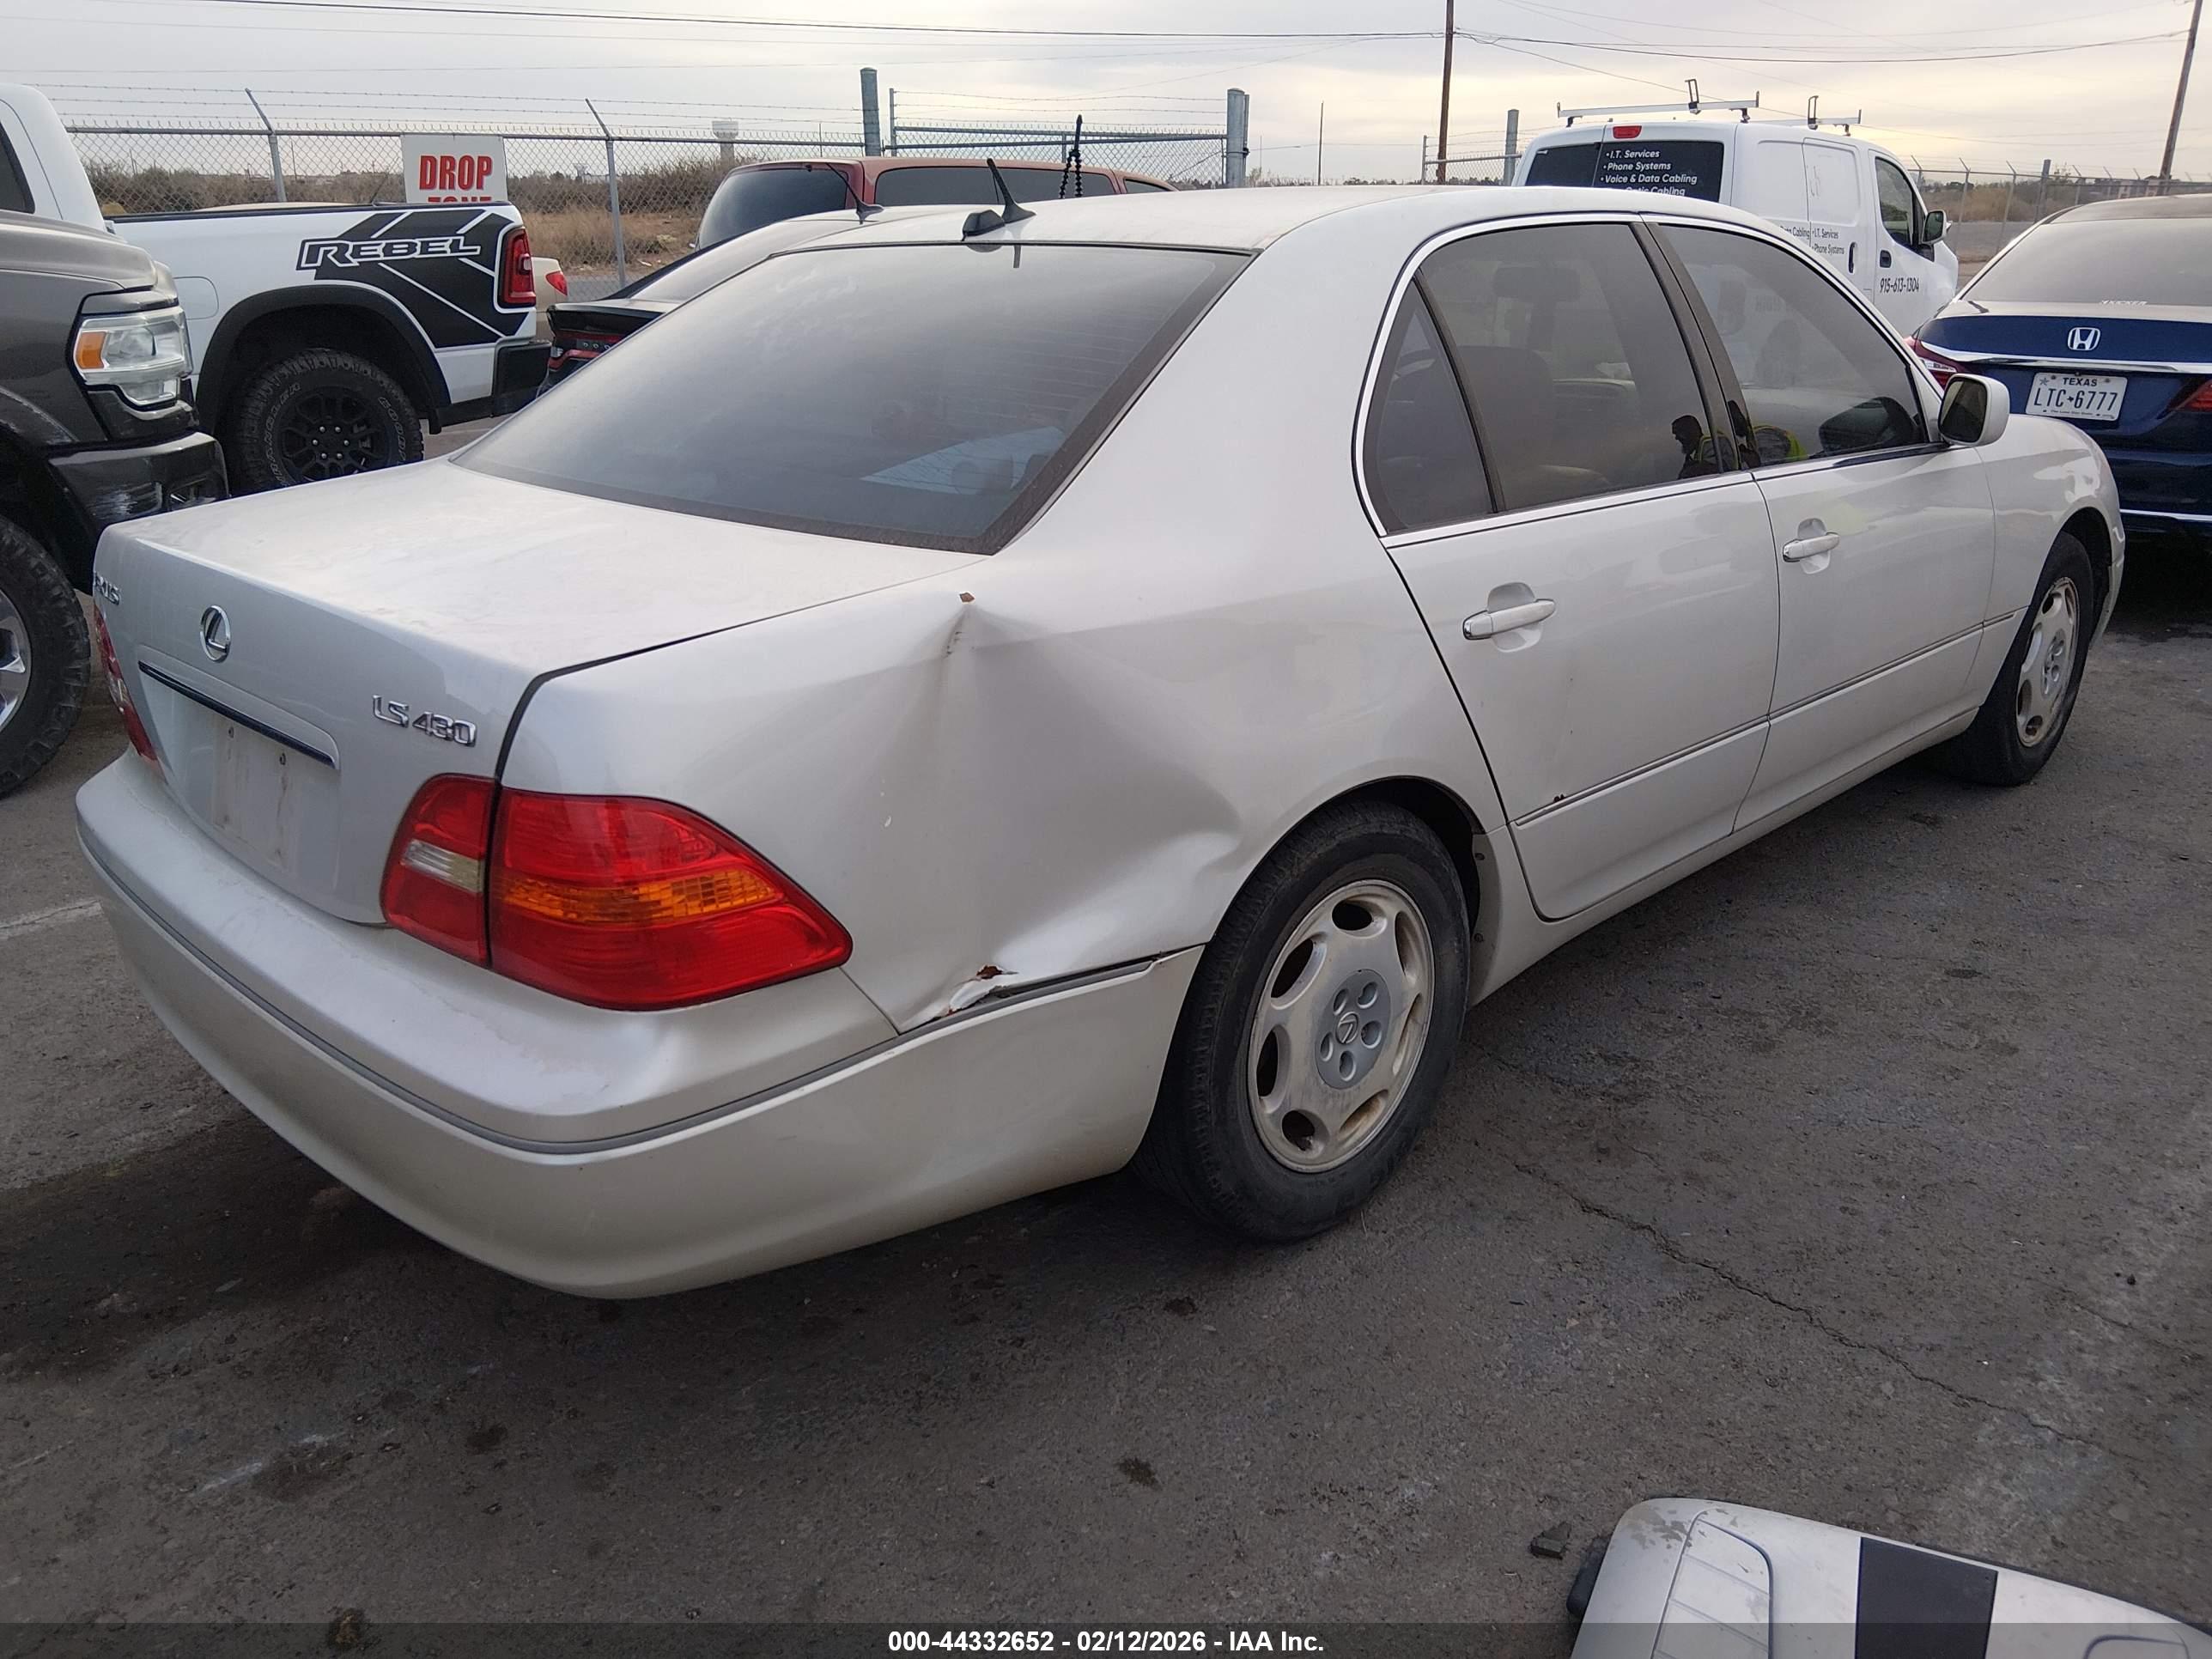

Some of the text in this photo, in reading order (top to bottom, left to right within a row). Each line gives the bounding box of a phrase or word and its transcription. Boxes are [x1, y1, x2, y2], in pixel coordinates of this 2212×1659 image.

[1610, 149, 1660, 159] I.T. Services
[1607, 161, 1671, 171] Phone Systems
[419, 155, 493, 191] DROP
[1605, 173, 1698, 185] Voice & Data Cabling
[1822, 228, 1838, 240] Services
[301, 235, 482, 267] REBEL
[1880, 277, 1919, 294] 915-613-1304
[2063, 377, 2098, 386] TEXAS
[373, 695, 477, 747] LS 430
